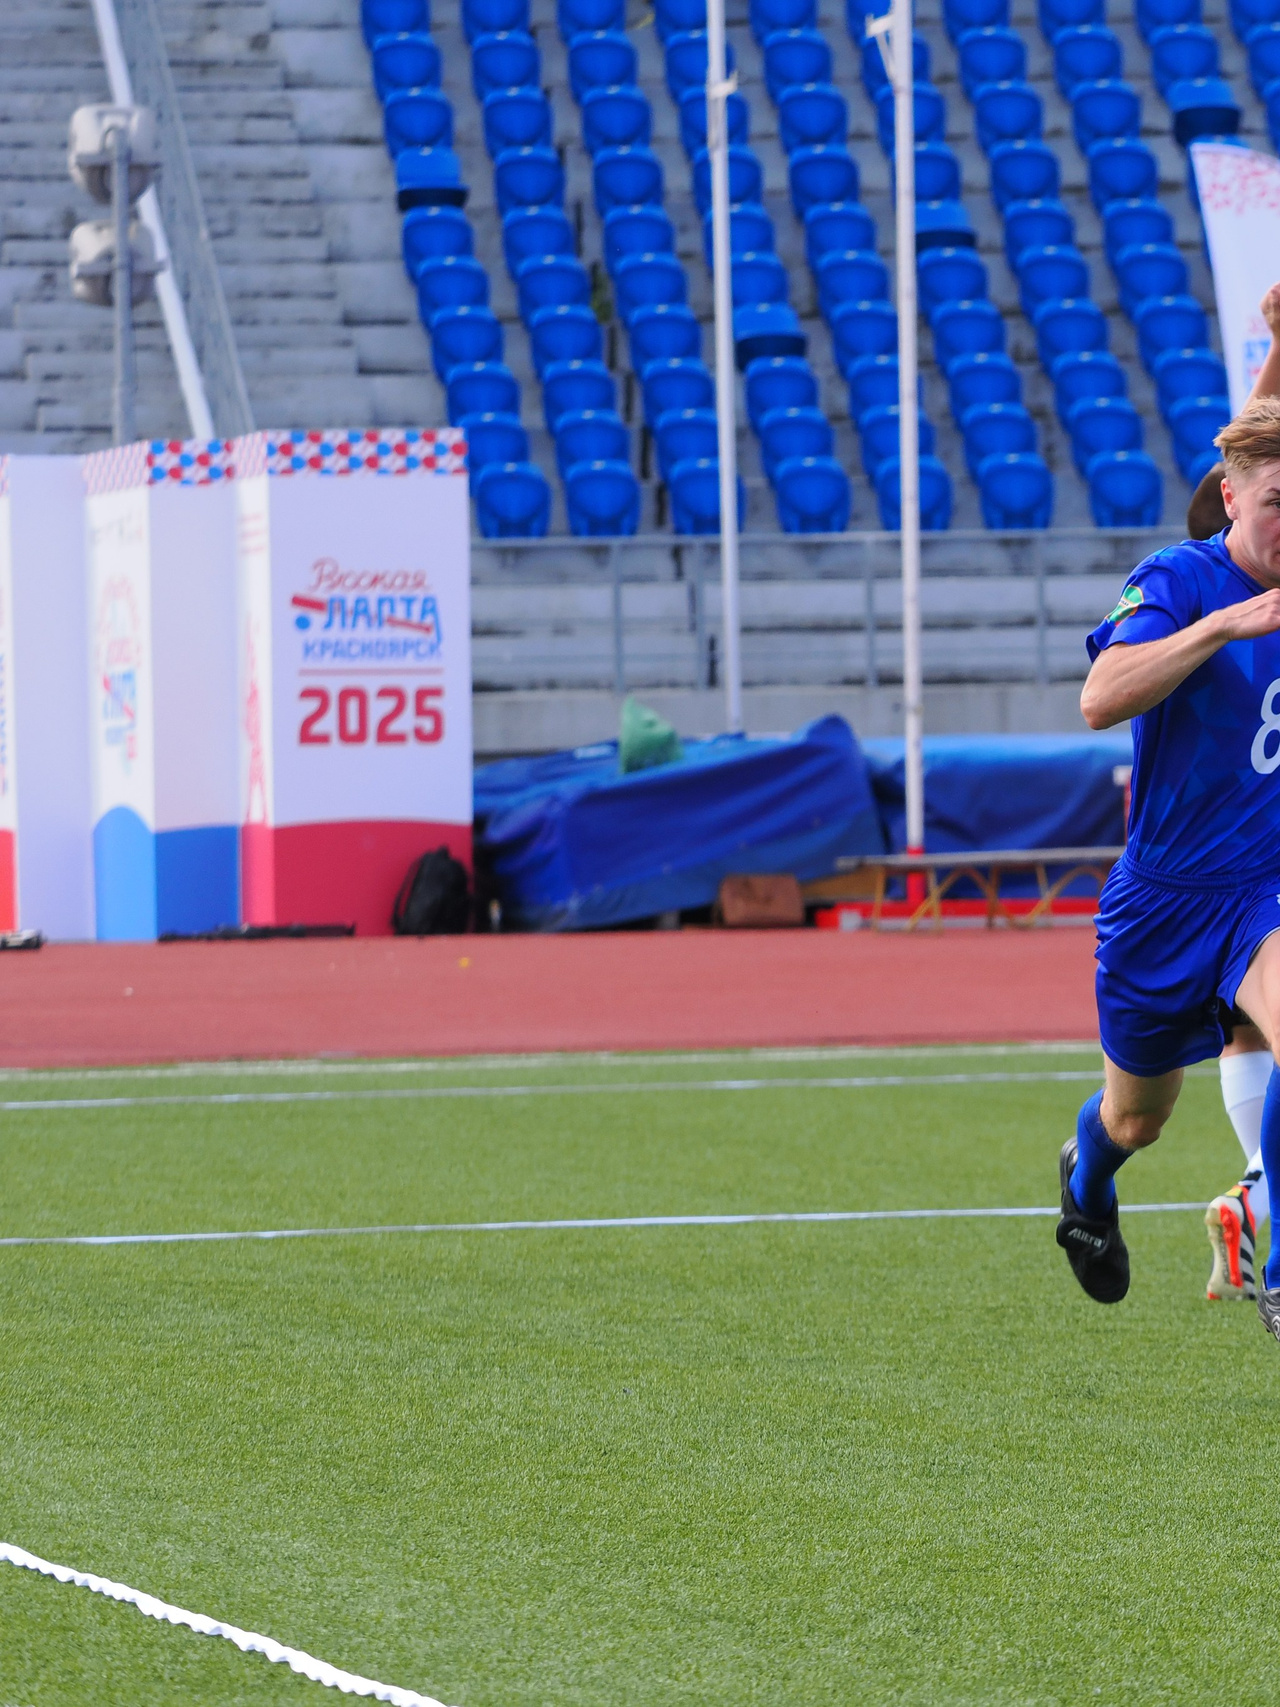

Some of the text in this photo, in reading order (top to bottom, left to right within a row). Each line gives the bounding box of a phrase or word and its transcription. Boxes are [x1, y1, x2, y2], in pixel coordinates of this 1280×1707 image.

[309, 556, 431, 592] Русская
[323, 595, 442, 644] ЛАПТА
[303, 639, 442, 660] КРАСНОЯРСК
[299, 686, 444, 744] 2025
